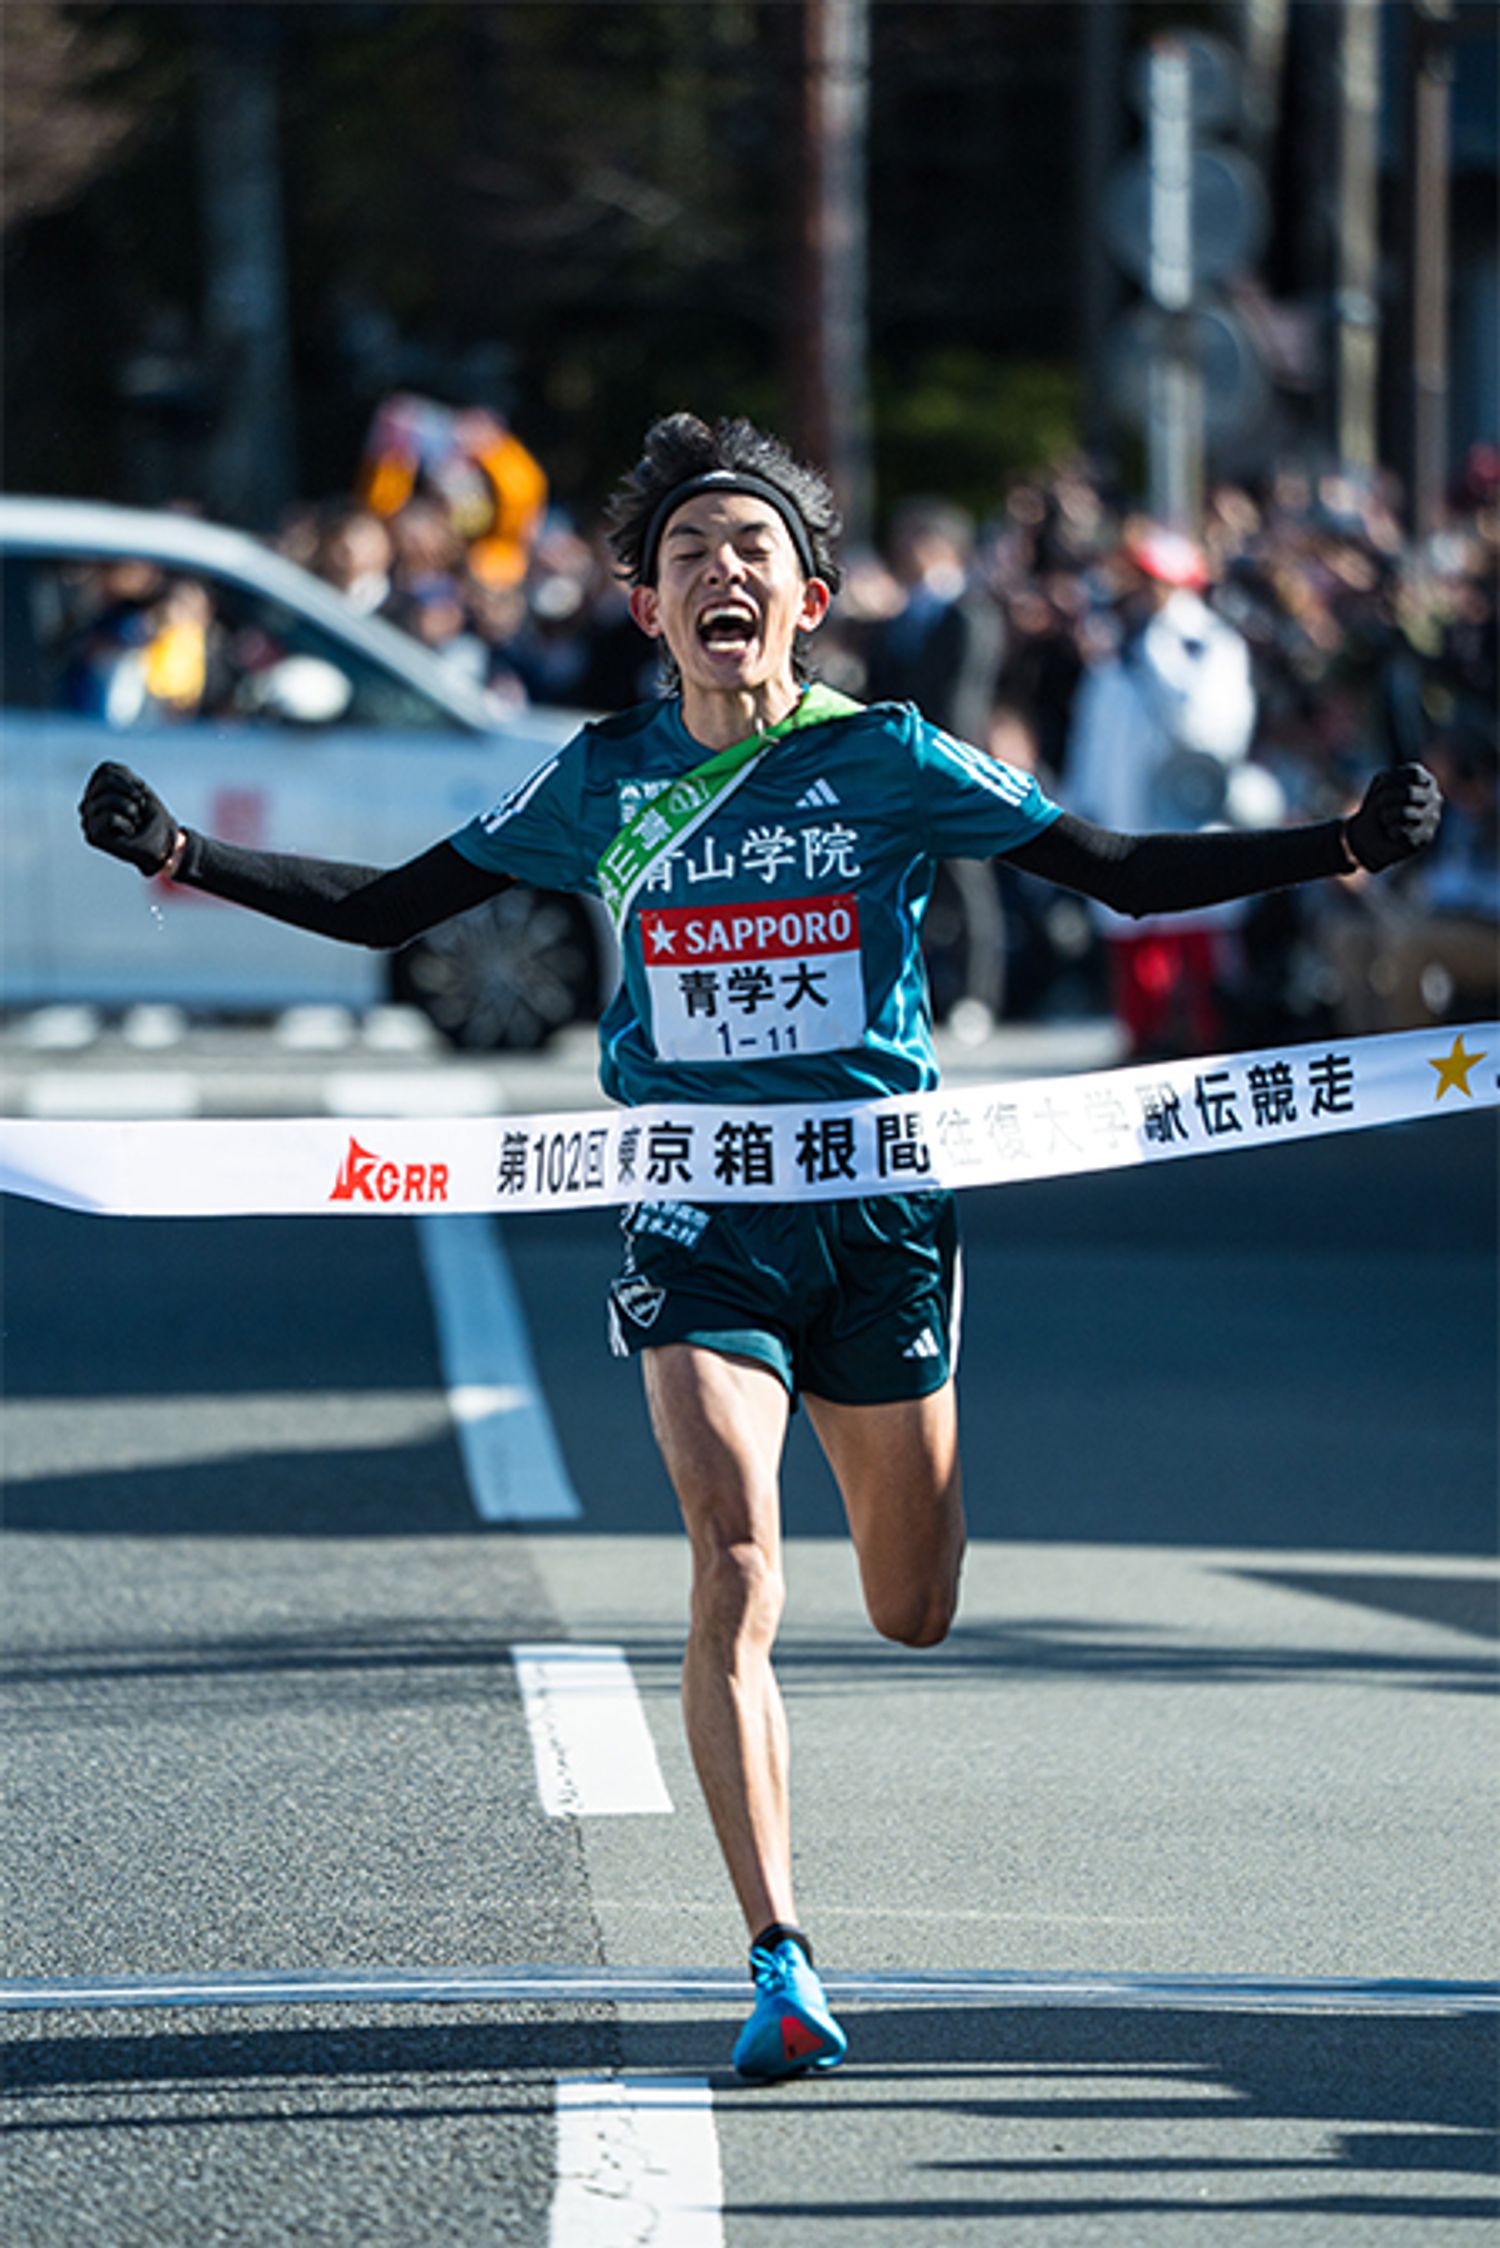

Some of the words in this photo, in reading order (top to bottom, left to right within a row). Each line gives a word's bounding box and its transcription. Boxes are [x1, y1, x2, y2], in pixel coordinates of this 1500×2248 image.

[684, 909, 852, 955] SAPPORO
[679, 961, 829, 1018] 青学大
[717, 1022, 799, 1055] 1-11
